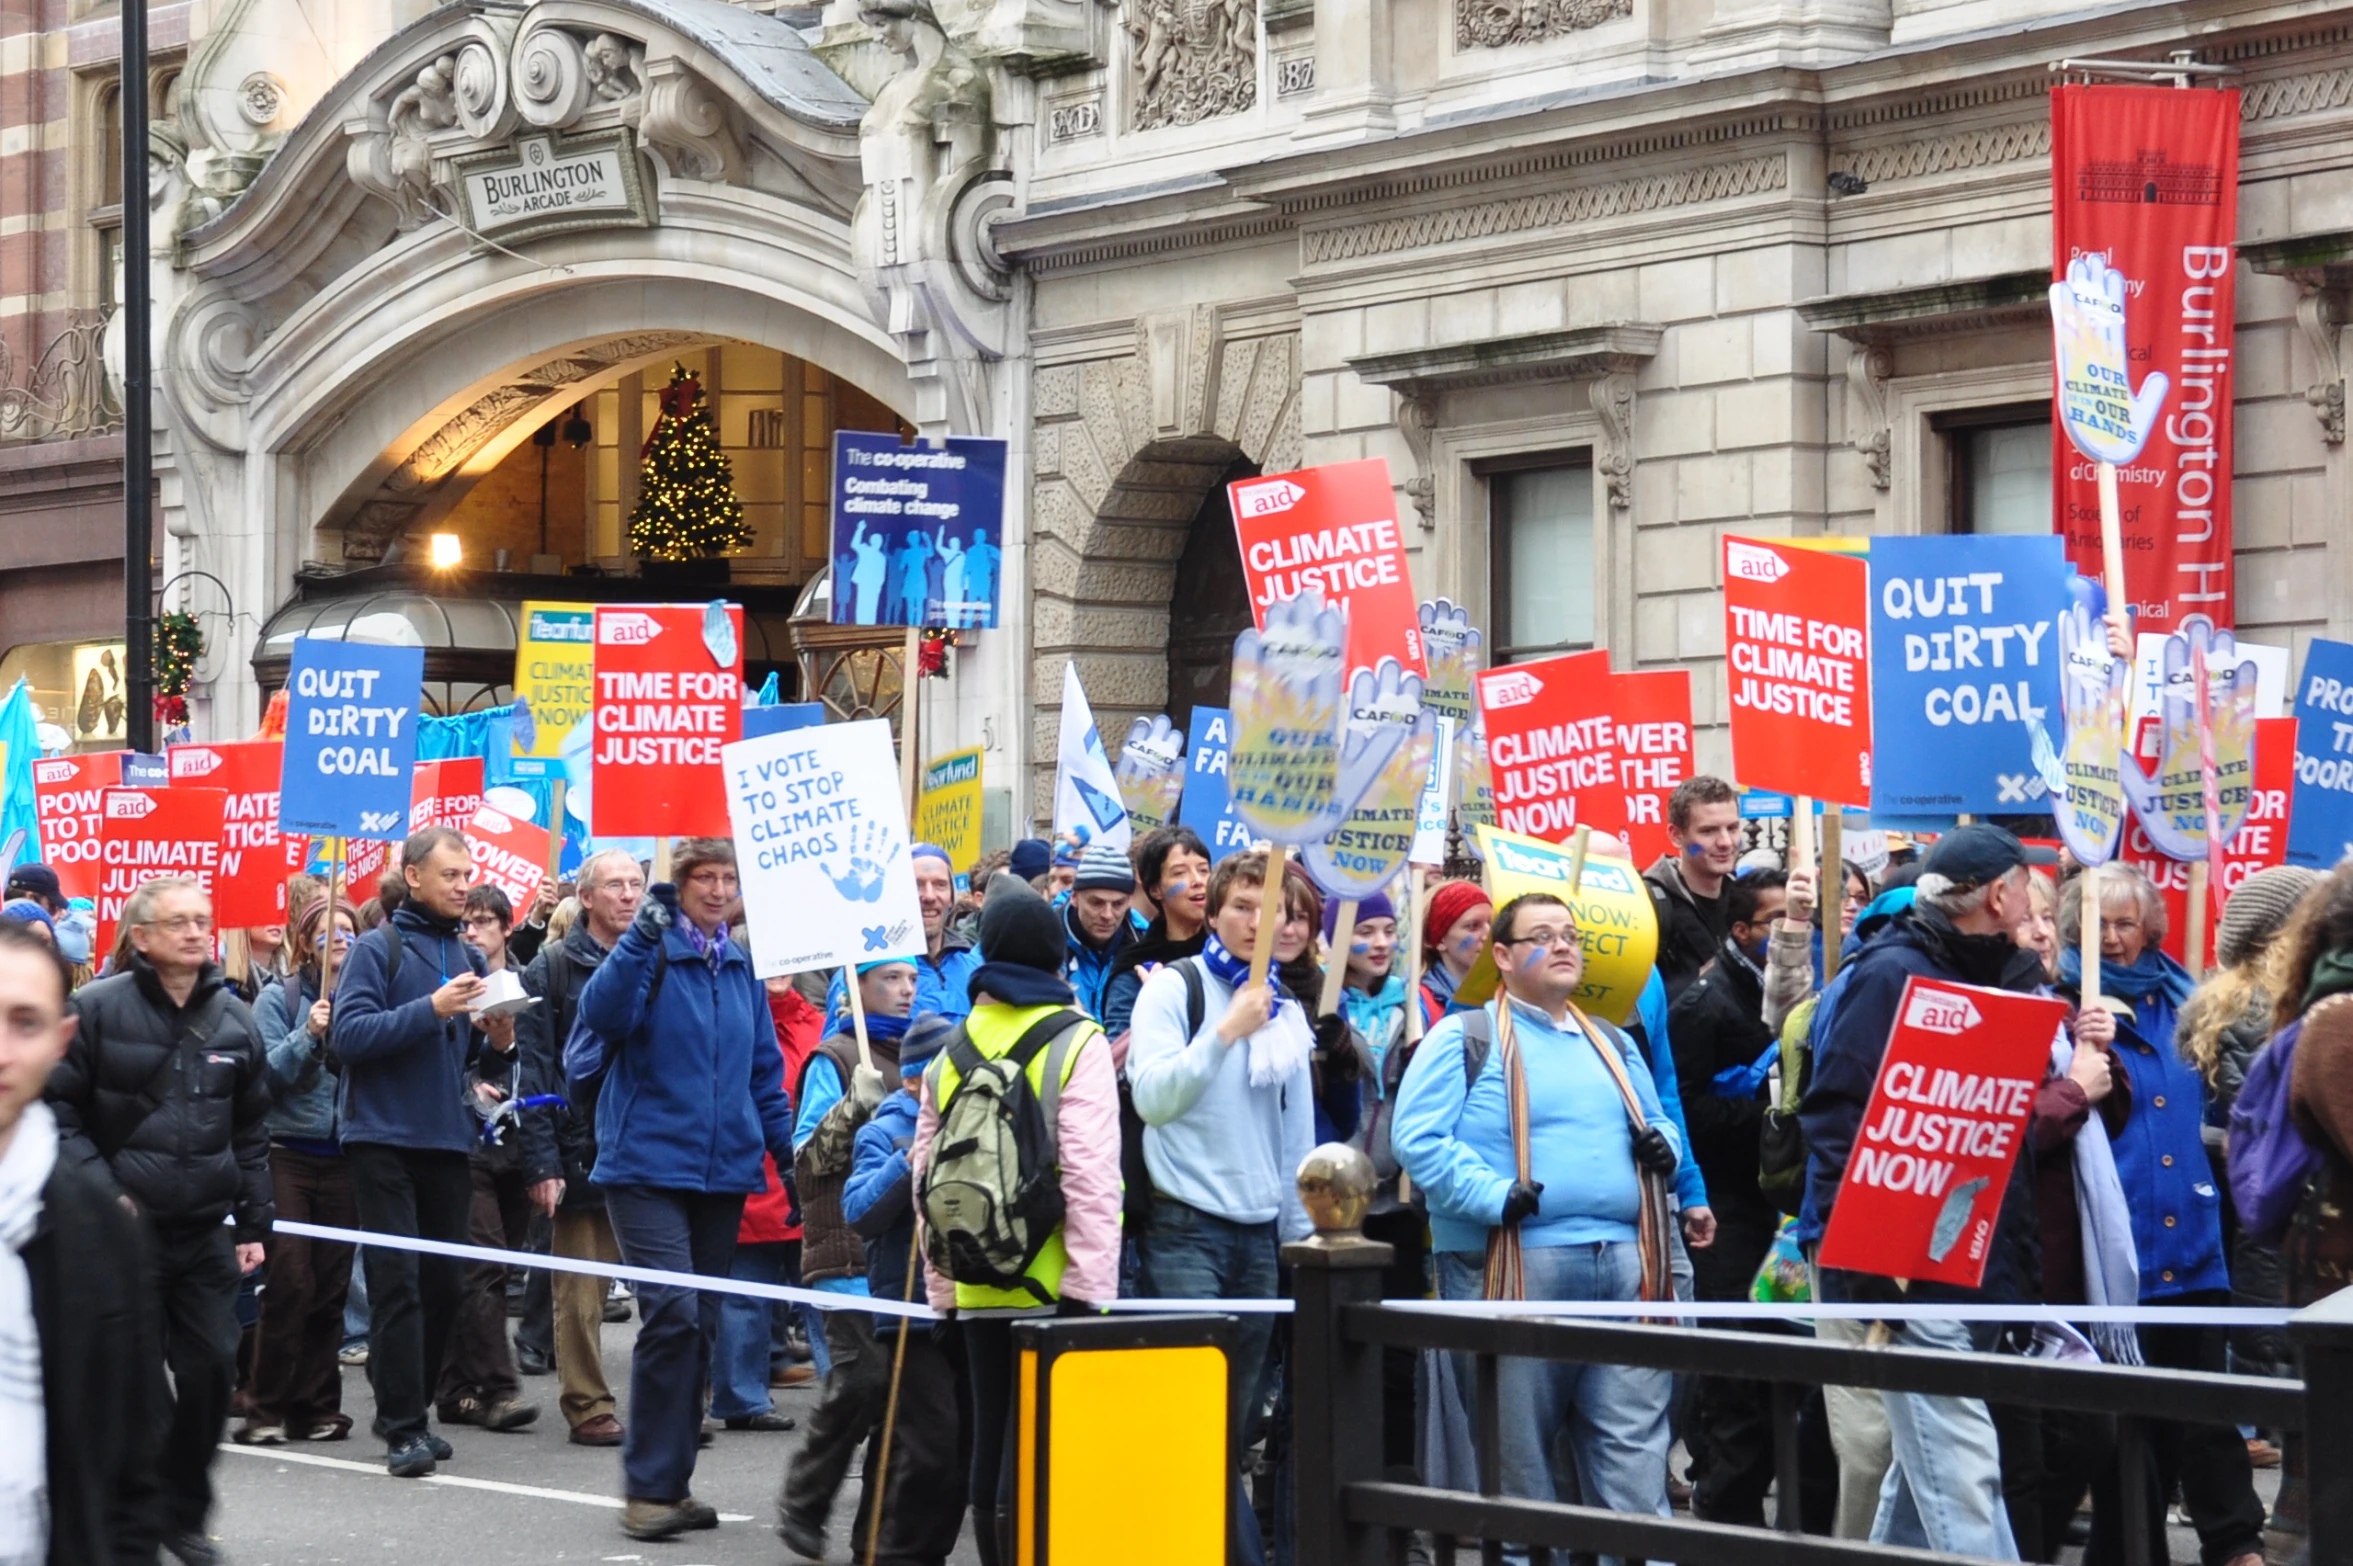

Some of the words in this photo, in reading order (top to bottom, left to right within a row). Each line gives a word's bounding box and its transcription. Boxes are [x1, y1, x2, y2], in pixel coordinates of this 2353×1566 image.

[482, 160, 605, 205] BURLINGTON
[523, 191, 572, 213] ARCADE
[2087, 363, 2127, 387] OUR
[2065, 380, 2128, 401] CLIMATE
[2165, 245, 2229, 542] Burlington
[2095, 399, 2131, 424] OUR
[2069, 406, 2138, 445] HANDS
[846, 448, 872, 466] The
[844, 476, 929, 500] Combating
[2084, 463, 2167, 488] Chmistry
[844, 496, 902, 514] climate
[904, 499, 960, 520] change
[1255, 485, 1297, 513] aid
[2068, 504, 2102, 521] Socie
[2124, 506, 2142, 522] of
[1249, 519, 1398, 572] CLIMATE
[1256, 554, 1400, 606] JUSTICE
[1741, 556, 1780, 578] aid
[1882, 572, 2003, 620] QUIT
[530, 613, 593, 641] tearfu
[613, 620, 652, 642] aid
[1729, 605, 1804, 647] TIME
[1806, 619, 1864, 659] FOR
[1405, 629, 1420, 661] OVER
[1904, 621, 2051, 672] DIRTY
[529, 662, 593, 681] CLIMAT
[1731, 642, 1854, 693] CLIMATE
[2147, 659, 2157, 676] I
[2168, 668, 2236, 686] CAOD
[298, 667, 380, 699] QUIT
[530, 685, 593, 706] JUSTIC
[597, 672, 673, 699] TIME
[678, 672, 737, 700] FOR
[1424, 688, 1470, 700] IMATE
[1497, 677, 1535, 704] aid
[2306, 675, 2353, 715] PRO
[1733, 678, 1853, 727] JUSTICE
[1925, 681, 2048, 727] COAL
[308, 705, 408, 738] DIRTY
[597, 705, 726, 733] CLIMATE
[1353, 708, 1417, 726] CAFOD
[596, 738, 722, 765] JUSTICE
[1491, 715, 1615, 767] CLIMATE
[46, 764, 74, 781] aid
[129, 765, 147, 777] The
[183, 752, 212, 775] aid
[318, 746, 399, 776] COAL
[737, 770, 750, 789] I
[757, 750, 821, 782] VOTE
[2065, 762, 2120, 784] CLIMATE
[1497, 752, 1615, 803] JUSTICE
[40, 789, 101, 816] POW
[117, 798, 148, 815] aid
[224, 791, 280, 820] MATE
[444, 795, 481, 813] FOR
[742, 790, 776, 815] TO
[786, 771, 844, 804] STOP
[2066, 786, 2120, 819] USTICE
[2143, 786, 2250, 814] JUSTCE
[2246, 790, 2286, 820] OR
[750, 798, 862, 843] CLIMATE
[1351, 808, 1415, 821] IMATE
[1501, 795, 1576, 835] NOW
[41, 817, 79, 840] TO
[223, 821, 280, 848] TICE
[1324, 829, 1411, 852] USTICE
[45, 838, 101, 864] POO
[103, 840, 218, 866] CLIMATE
[347, 841, 365, 863] THE
[464, 834, 544, 888] POWER
[758, 832, 838, 870] CHAOS
[1332, 851, 1389, 874] NOW
[347, 865, 357, 886] IS
[1494, 841, 1630, 892] tearfnd
[779, 951, 833, 966] co-operative
[1921, 1003, 1968, 1030] aid
[1883, 1061, 2035, 1117] CLIMATE
[1866, 1105, 2016, 1160] JUSTICE
[1852, 1146, 1955, 1198] NOW
[1968, 1219, 1989, 1262] OVER
